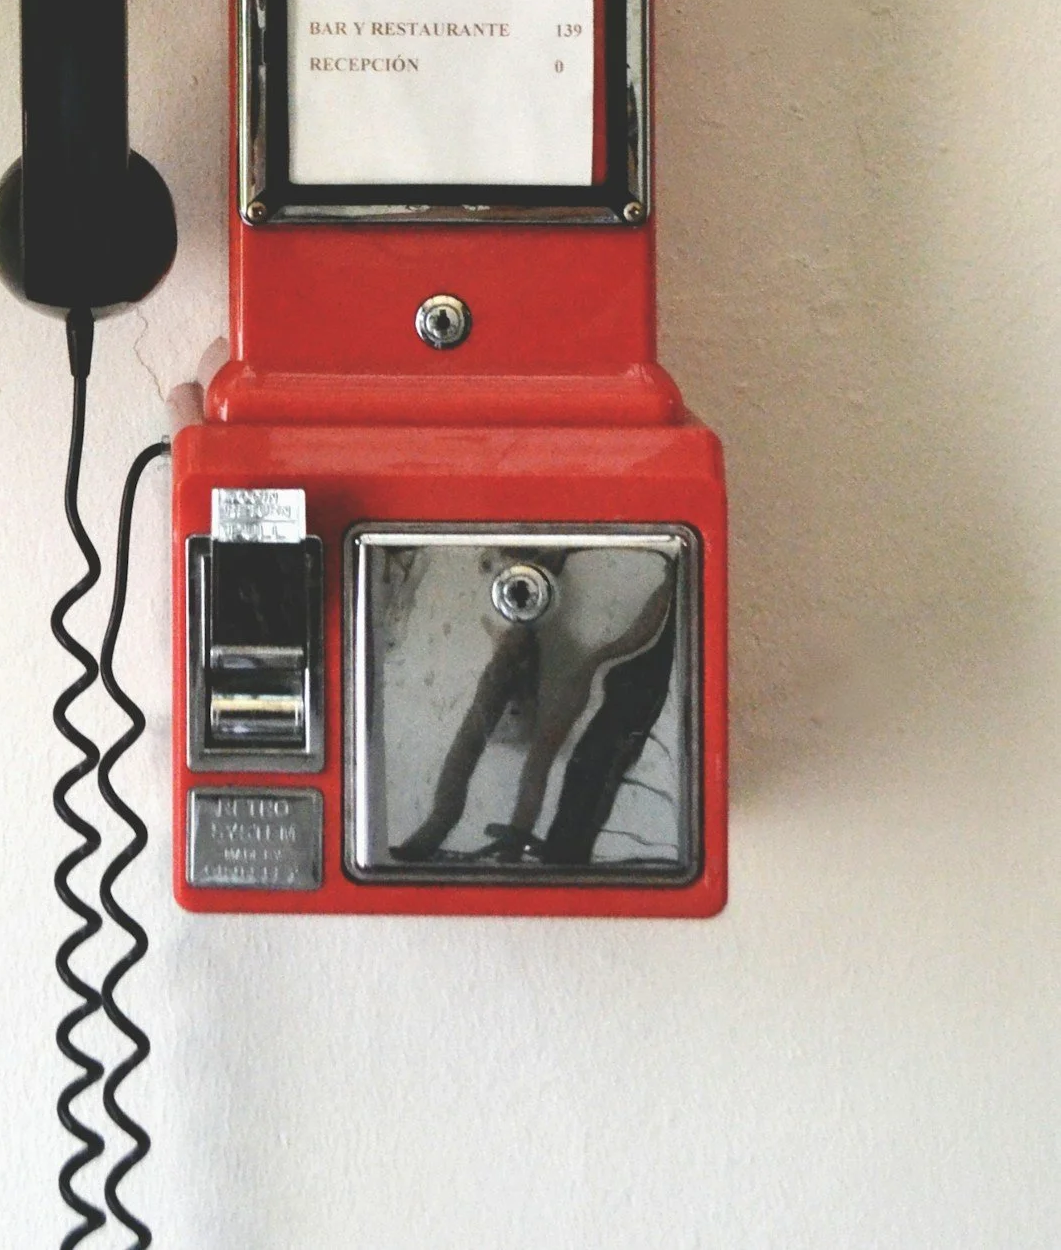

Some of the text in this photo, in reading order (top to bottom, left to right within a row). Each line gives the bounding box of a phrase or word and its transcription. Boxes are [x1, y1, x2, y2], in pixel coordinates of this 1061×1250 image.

[309, 21, 583, 38] BAR Y RESTAURANTE 139
[309, 54, 564, 74] RECEPCIÓN 0
